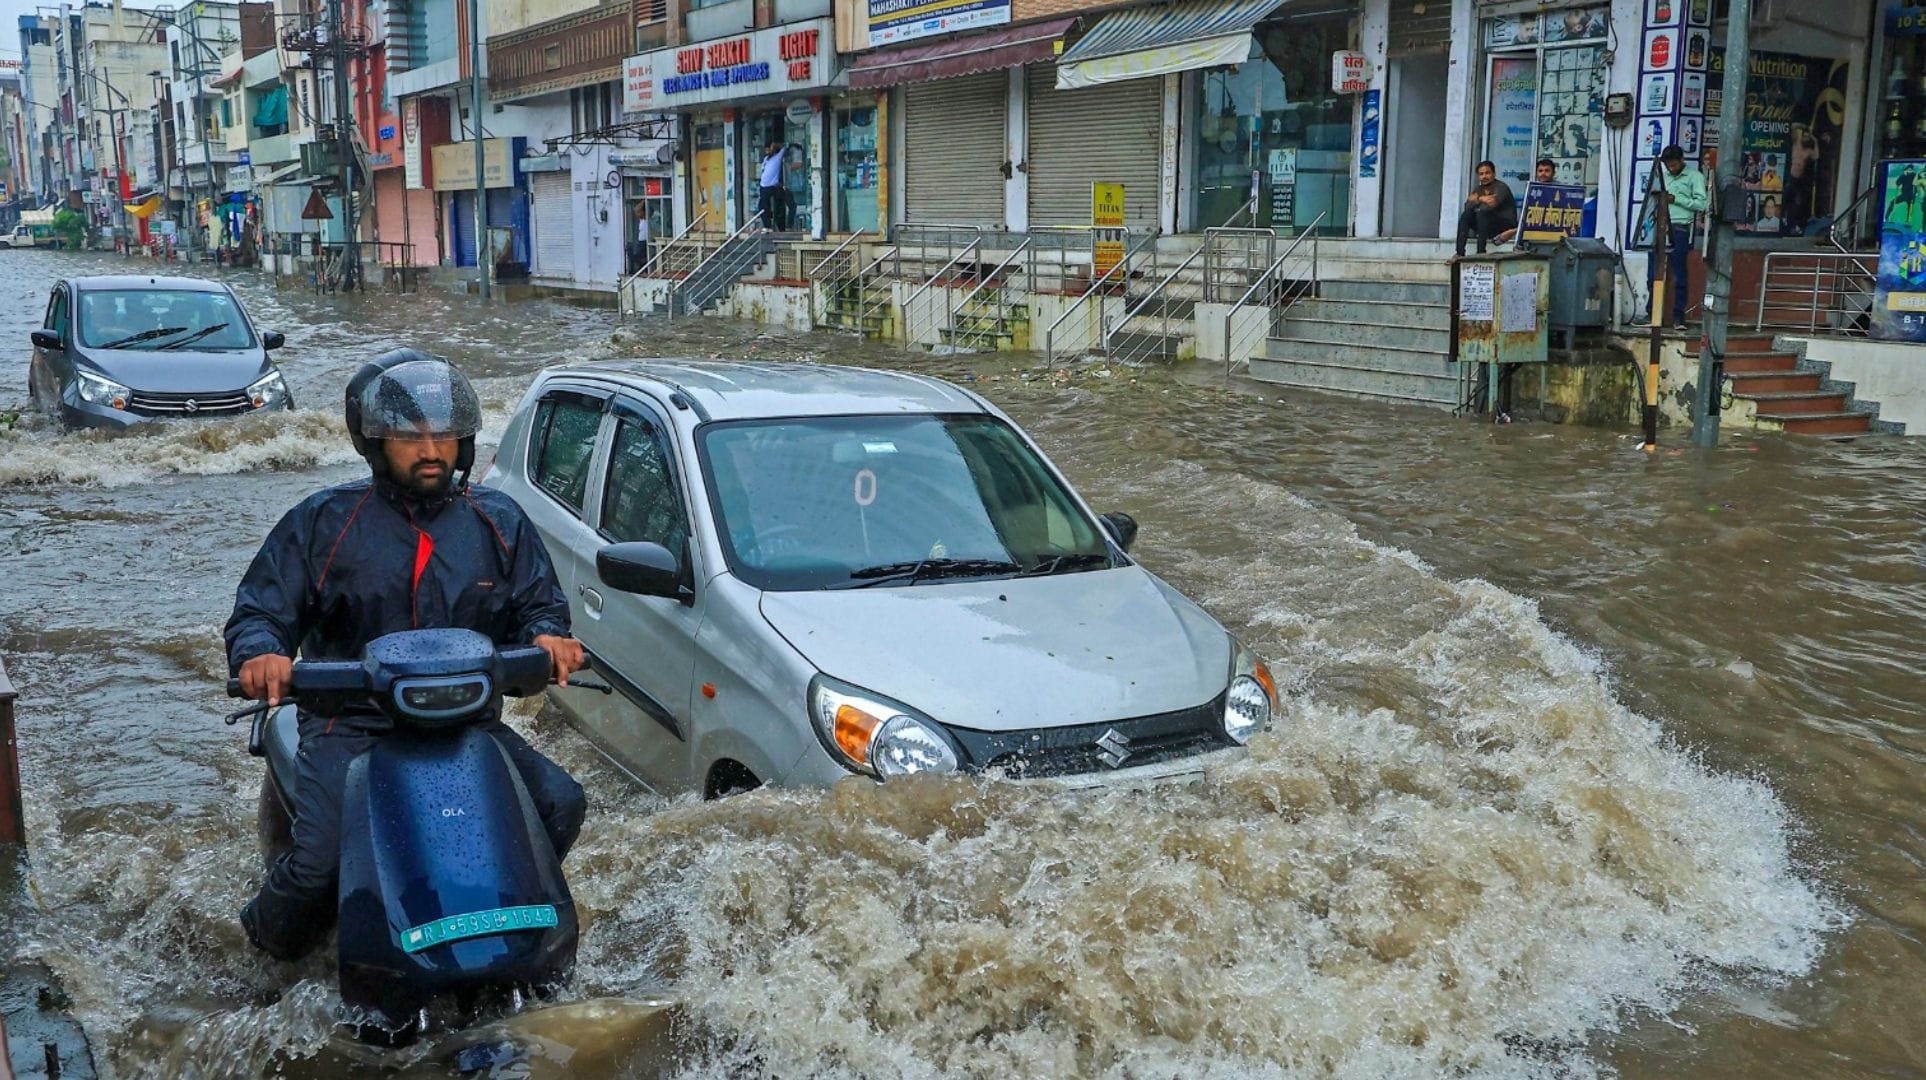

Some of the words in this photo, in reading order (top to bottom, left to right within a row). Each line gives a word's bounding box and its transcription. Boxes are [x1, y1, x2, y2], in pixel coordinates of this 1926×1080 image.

[779, 29, 819, 60] LIGHT
[677, 48, 704, 74] SHIV
[707, 38, 750, 69] SHAKTI
[1343, 53, 1364, 68] सेल
[730, 62, 770, 84] APPLIANCES
[787, 61, 811, 81] ZONE
[1750, 120, 1790, 134] OPENING
[1751, 137, 1785, 149] Jaipur
[1271, 163, 1295, 172] TITAN
[1099, 203, 1120, 213] TITAN
[442, 808, 465, 817] OLA
[424, 922, 447, 942] RJ
[512, 908, 554, 925] 1642
